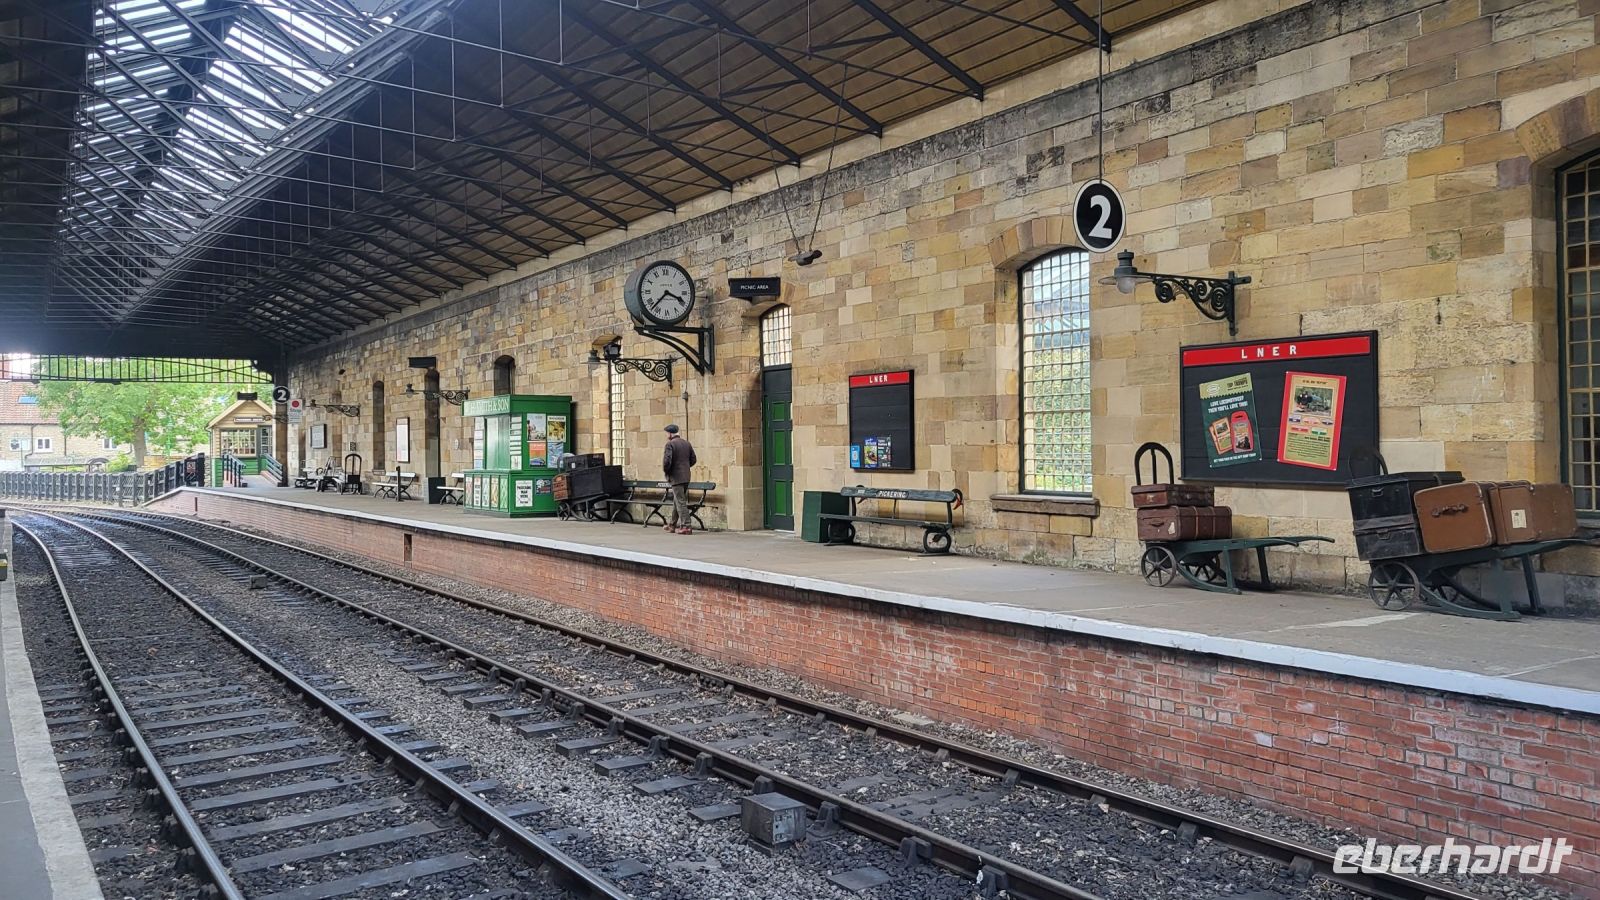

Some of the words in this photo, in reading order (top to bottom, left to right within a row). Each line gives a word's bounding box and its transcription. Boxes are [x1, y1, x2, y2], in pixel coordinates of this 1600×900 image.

[1088, 194, 1112, 239] 2
[869, 374, 888, 384] LNER
[277, 389, 287, 400] 2
[498, 398, 509, 411] SON
[879, 490, 907, 498] PICKERING
